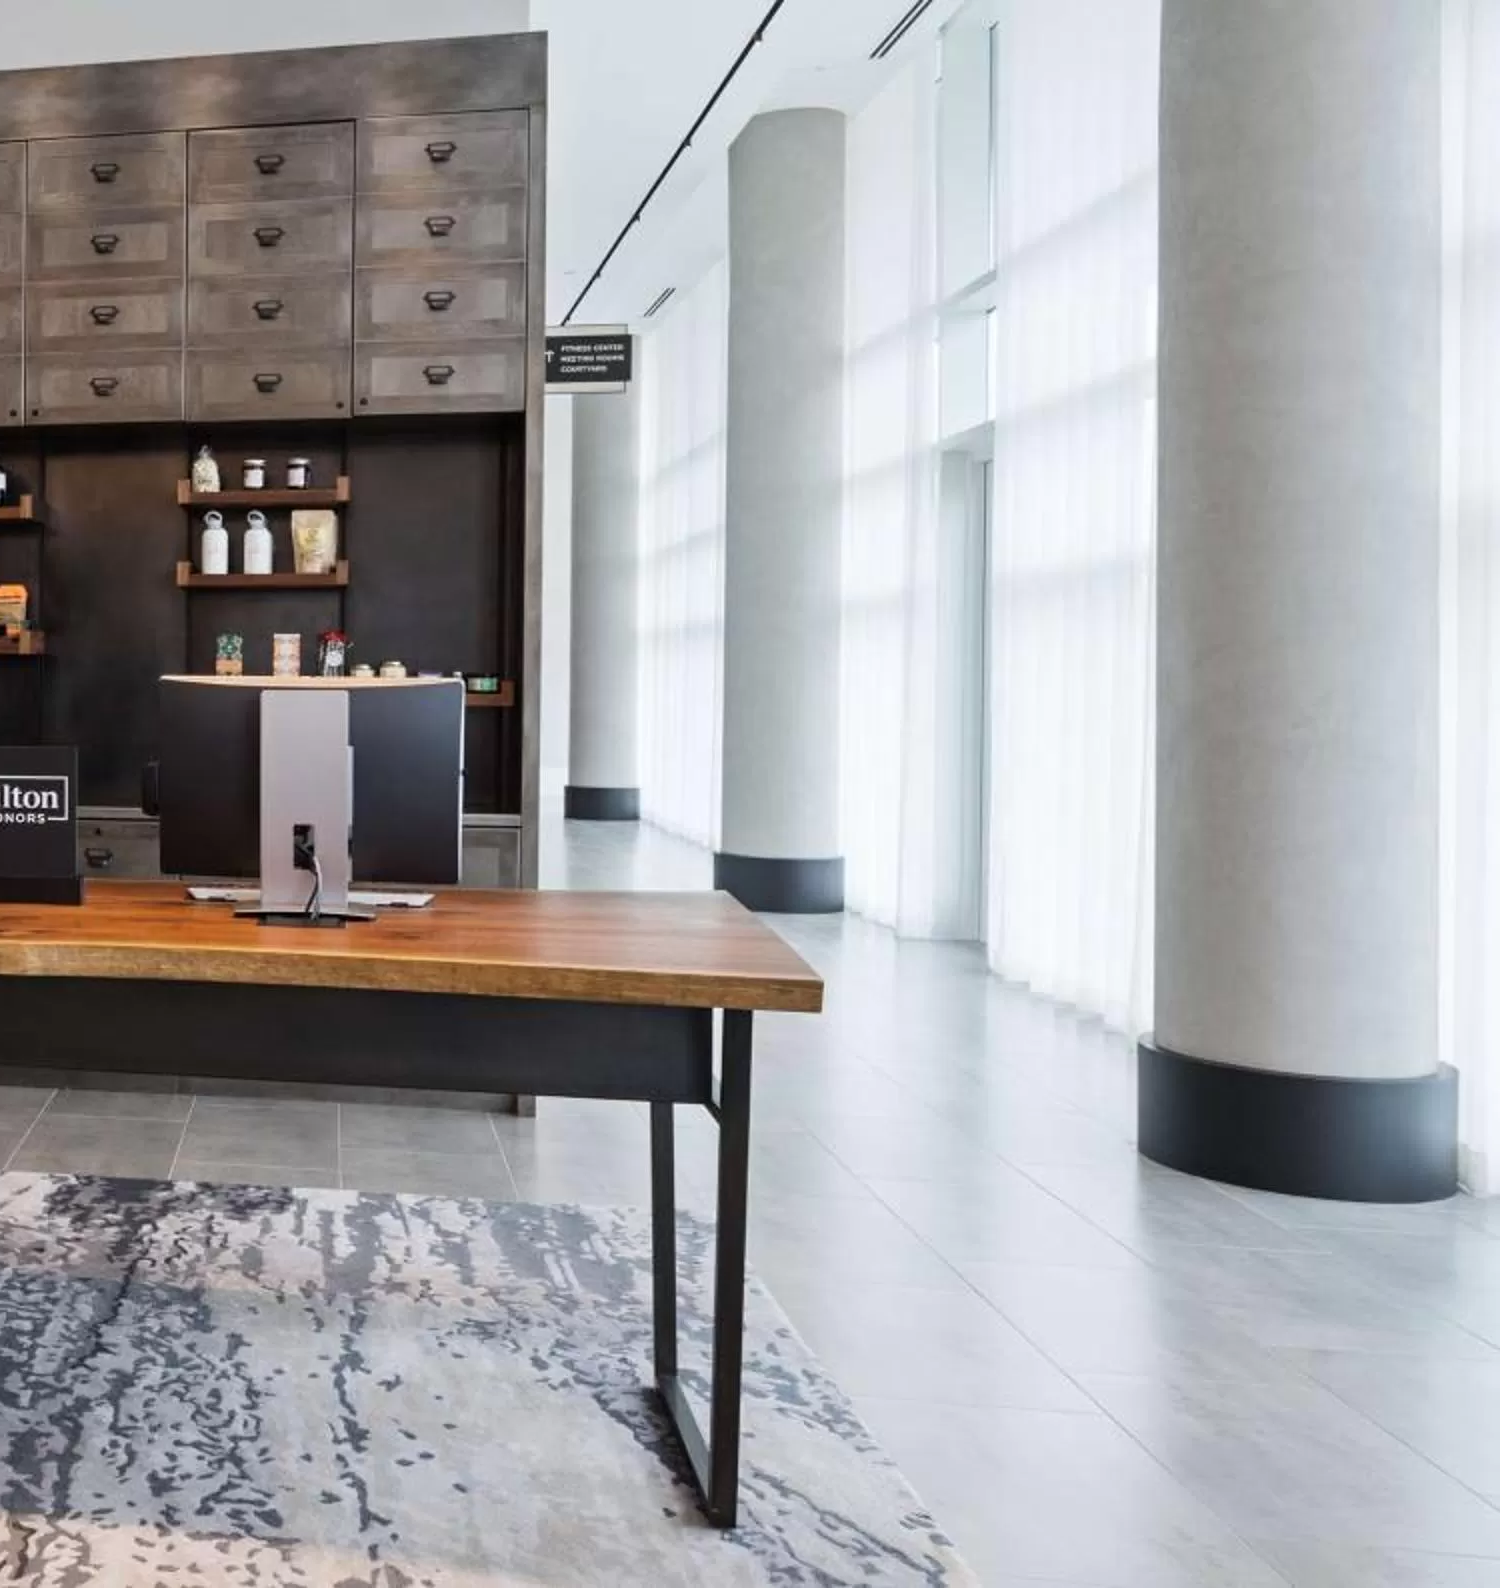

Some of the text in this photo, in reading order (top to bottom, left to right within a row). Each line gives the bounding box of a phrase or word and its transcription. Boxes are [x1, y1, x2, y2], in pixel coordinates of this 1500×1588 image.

[593, 344, 624, 352] CENTER
[596, 354, 624, 362] ROOMS
[560, 365, 607, 373] COURTYARD
